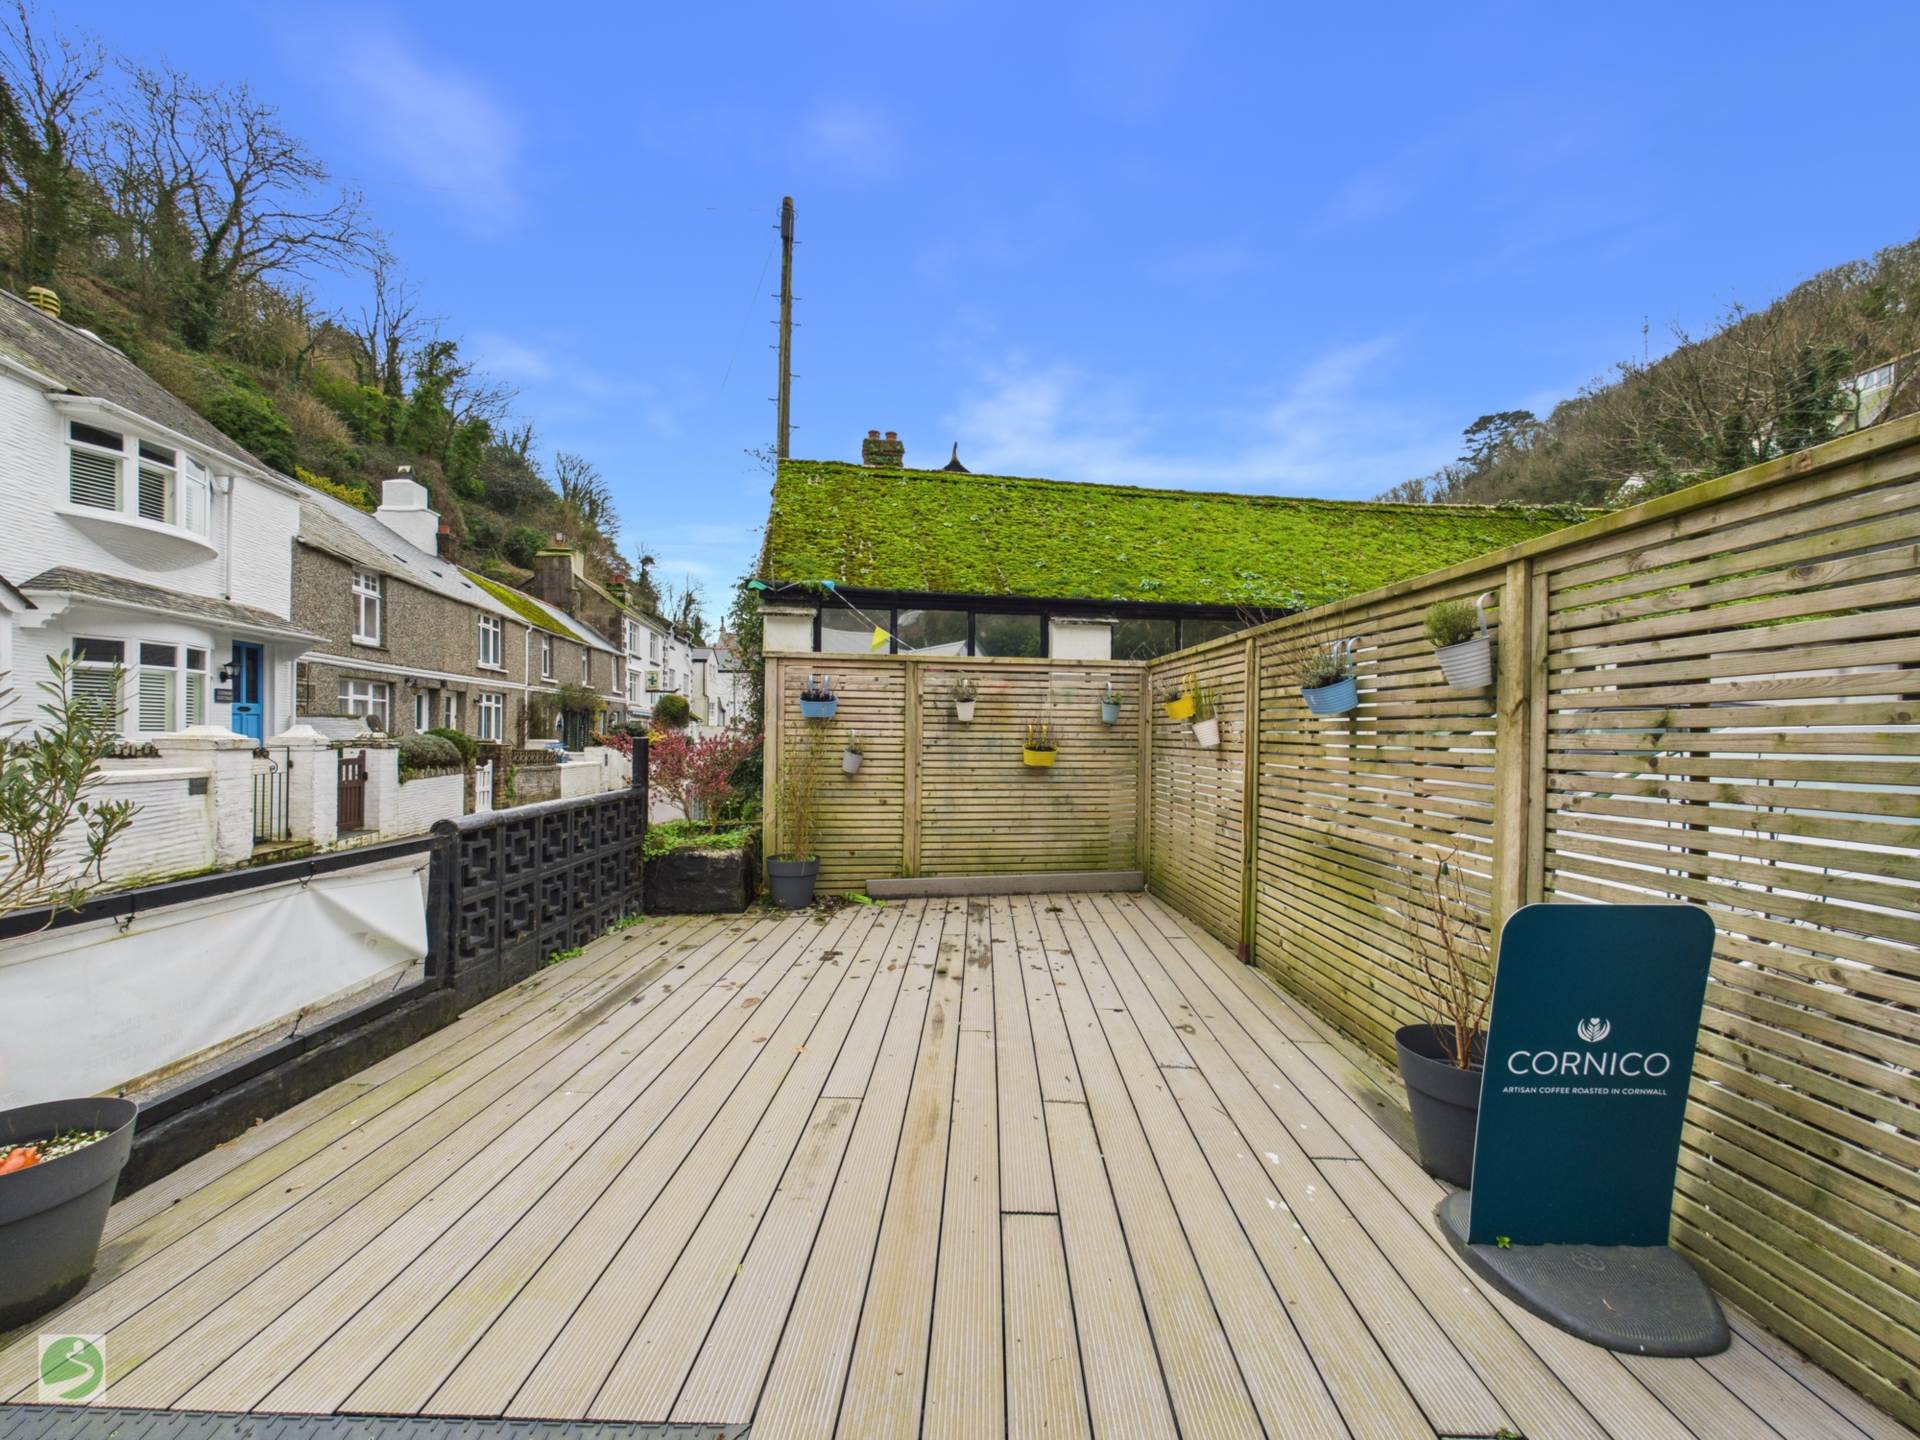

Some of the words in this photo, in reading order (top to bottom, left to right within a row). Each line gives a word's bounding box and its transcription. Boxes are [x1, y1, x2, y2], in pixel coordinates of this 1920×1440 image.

[1507, 1051, 1670, 1076] CORNICO
[1502, 1086, 1537, 1094] ARTISAN
[1572, 1087, 1609, 1095] ROASTED
[1611, 1087, 1621, 1095] IN
[1622, 1088, 1667, 1096] CORNWALL
